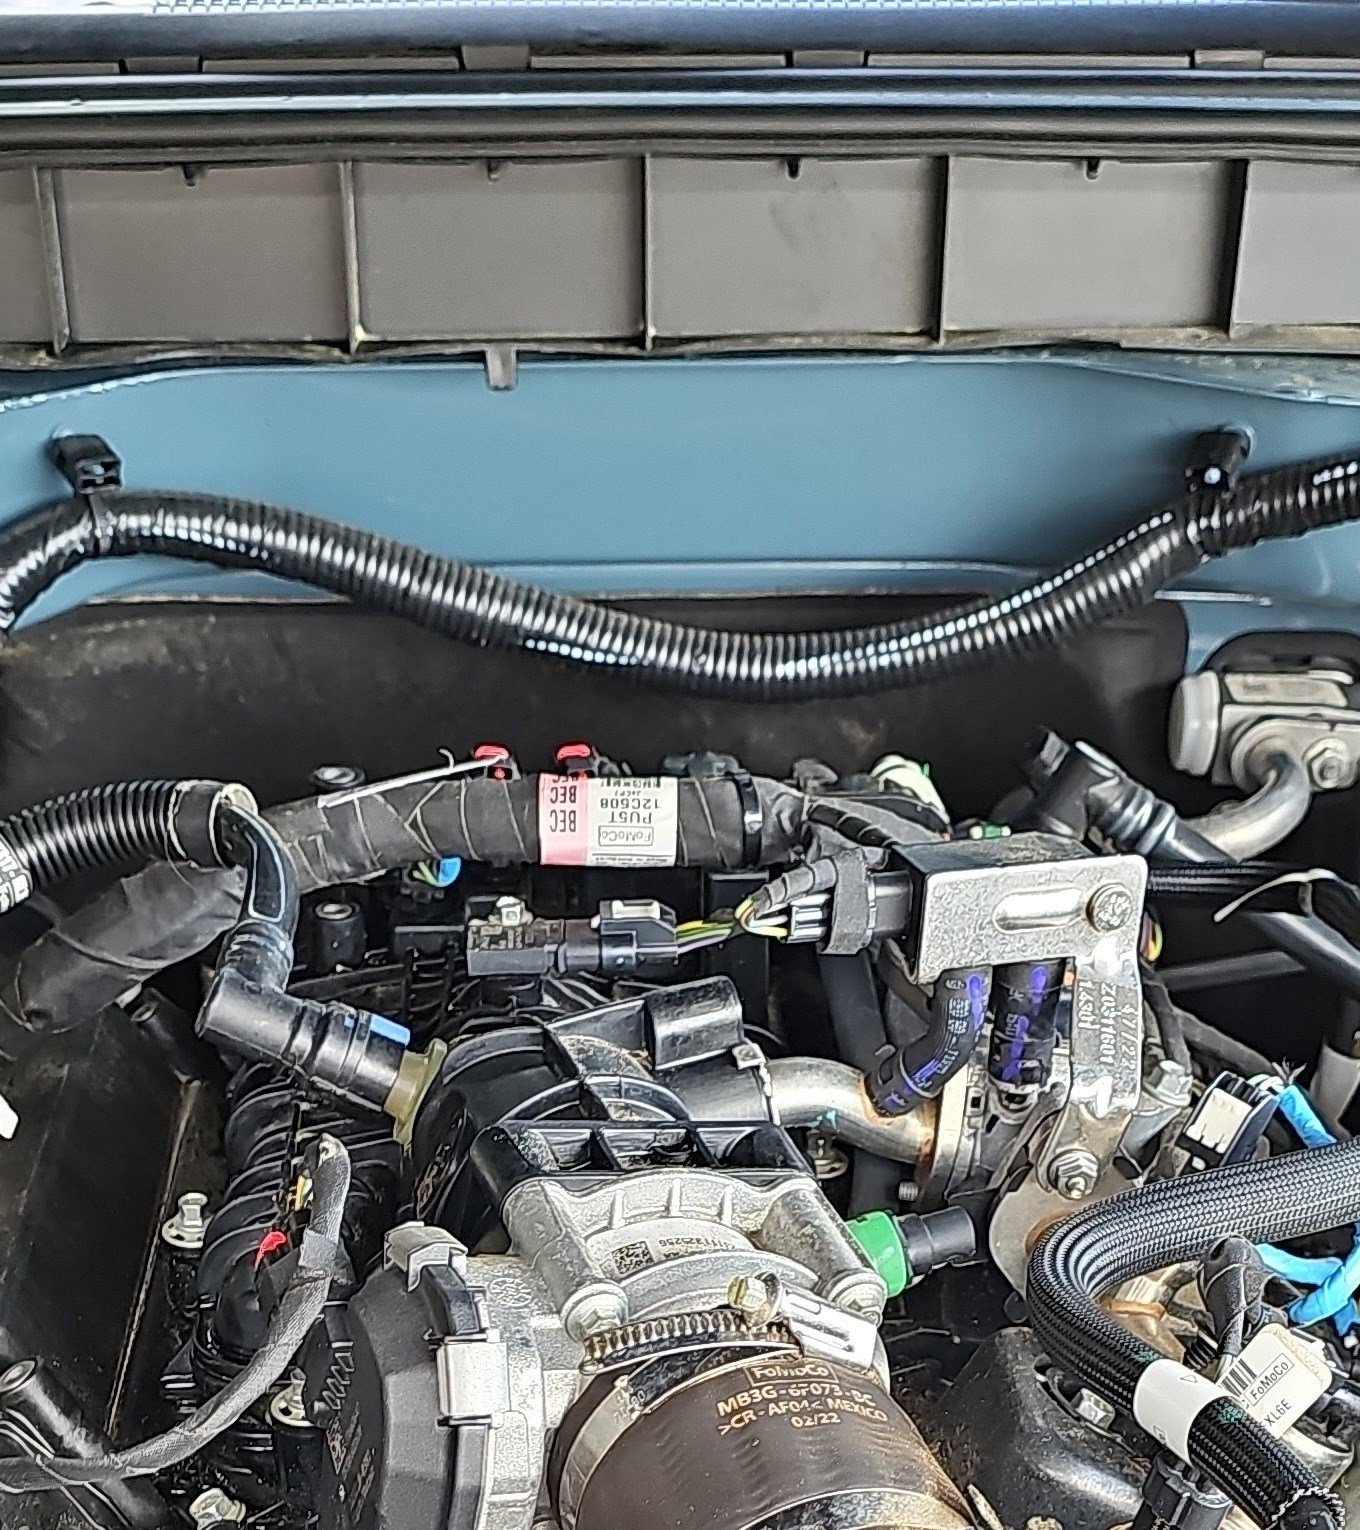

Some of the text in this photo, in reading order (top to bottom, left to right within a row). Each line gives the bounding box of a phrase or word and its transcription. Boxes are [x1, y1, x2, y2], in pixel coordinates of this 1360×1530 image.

[549, 786, 576, 803] BEC
[599, 797, 660, 808] 12C508
[549, 809, 576, 831] BEC
[607, 810, 652, 823] PU5T
[601, 829, 650, 841] FoMoCo
[750, 1364, 829, 1378] FoMoCo
[1252, 1361, 1288, 1400] FoMoCo
[828, 1398, 888, 1421] MEXICO
[791, 1413, 841, 1427] 02/22
